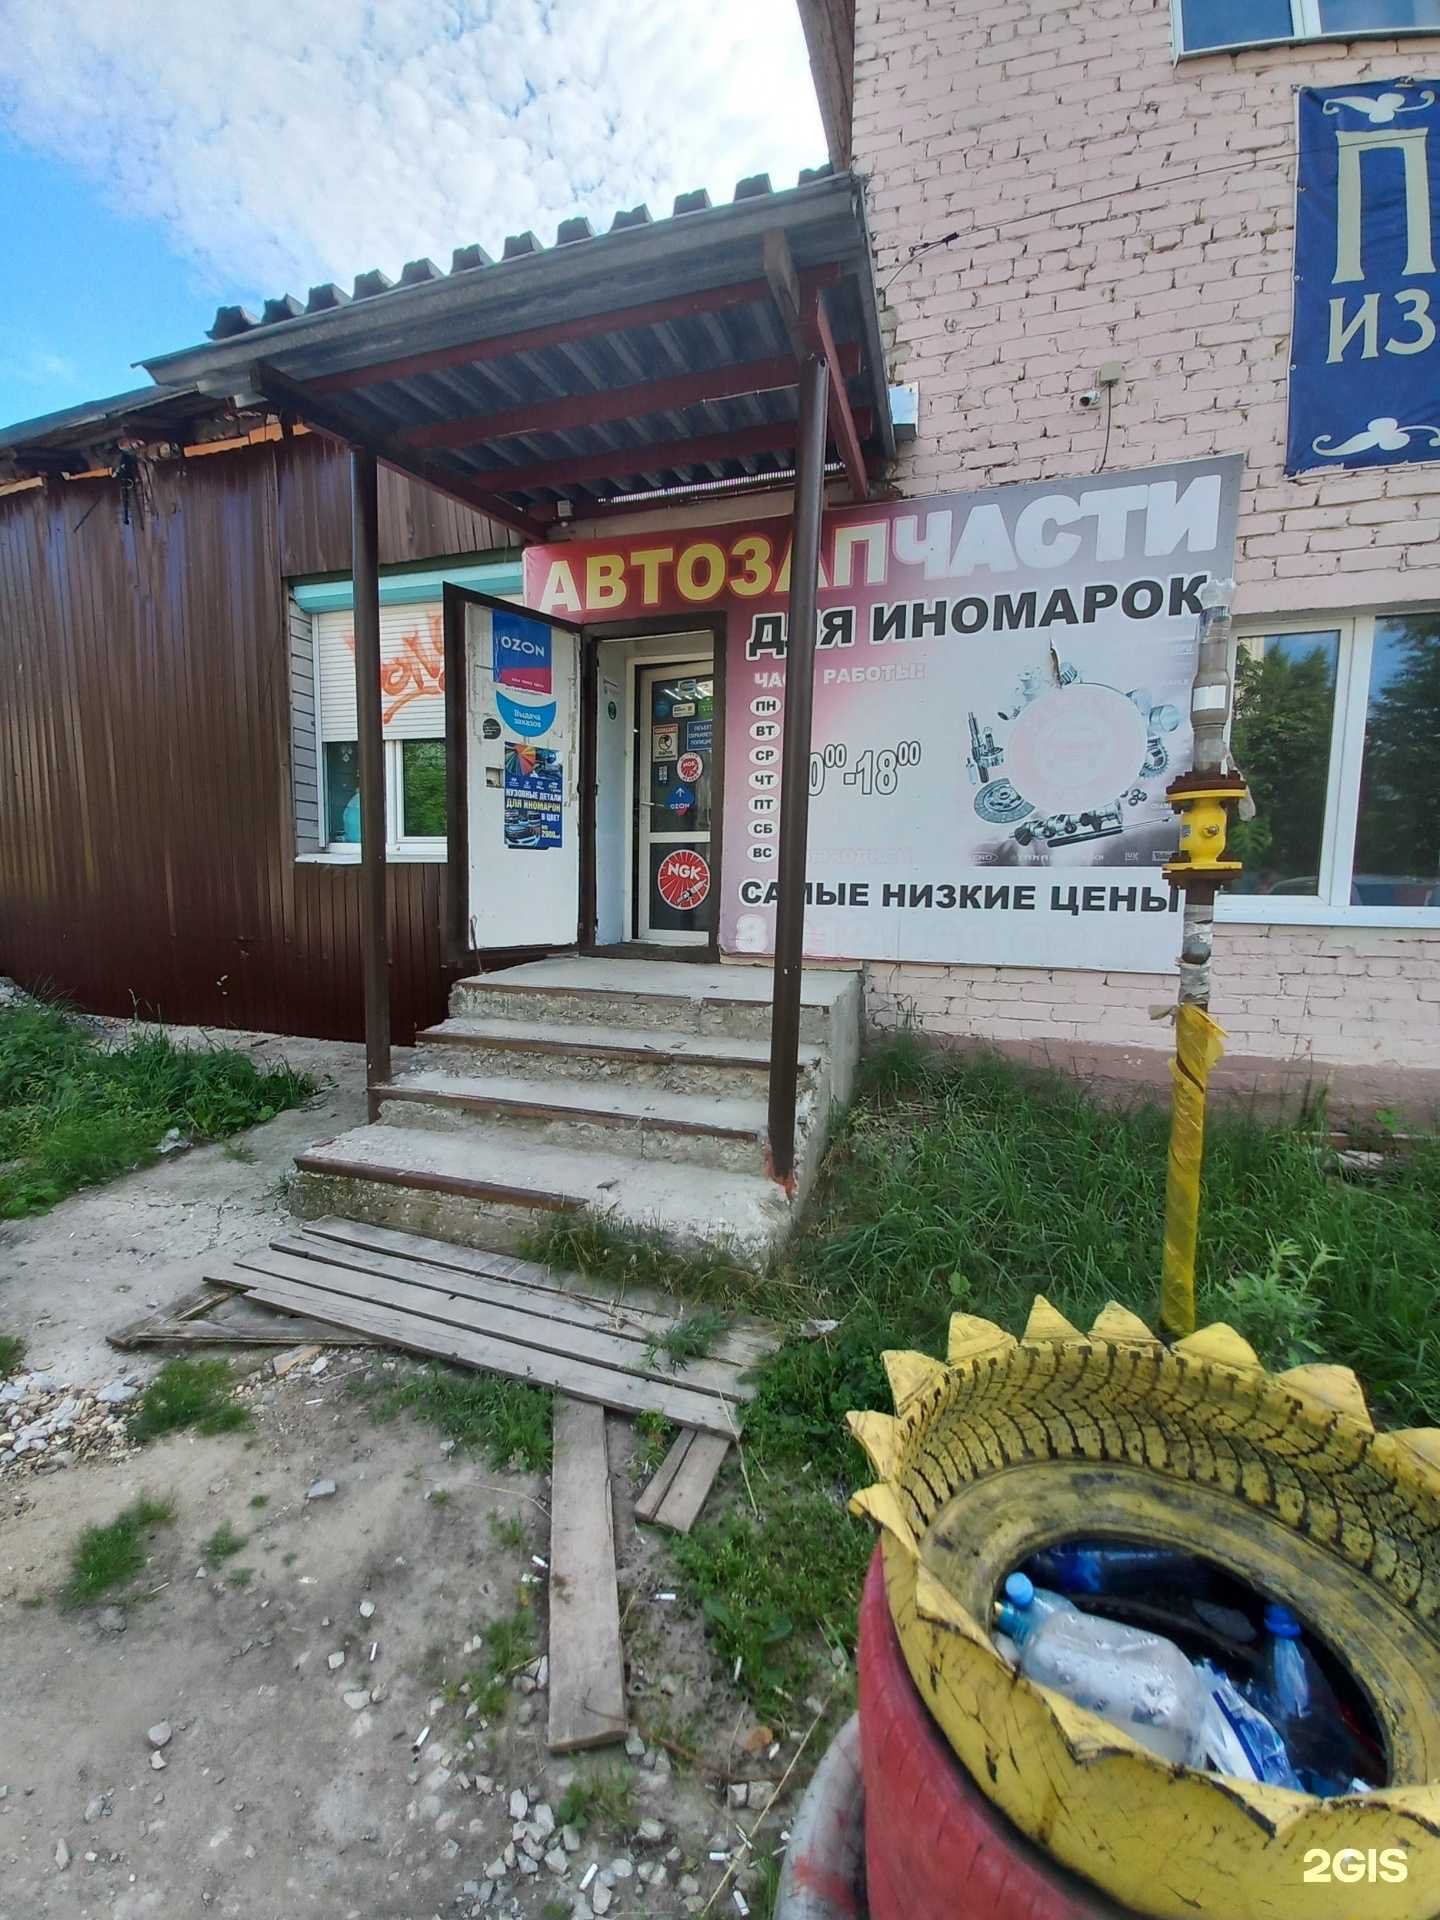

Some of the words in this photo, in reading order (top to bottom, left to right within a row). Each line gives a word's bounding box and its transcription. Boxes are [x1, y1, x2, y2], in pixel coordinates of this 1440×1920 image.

[748, 609, 853, 658] ДЯ
[872, 574, 1208, 642] ИНОМАРОК
[501, 636, 545, 658] OZON
[755, 700, 776, 712] ПН
[755, 725, 775, 737] ВТ
[755, 750, 775, 761] СР
[754, 775, 774, 786] ЧТ
[754, 800, 774, 810] ПТ
[753, 823, 773, 834] СБ
[752, 848, 772, 858] ВС
[667, 863, 701, 881] NGK
[882, 883, 1036, 910] НИЗКИЕ
[1051, 885, 1179, 916] ЦЕНЫ
